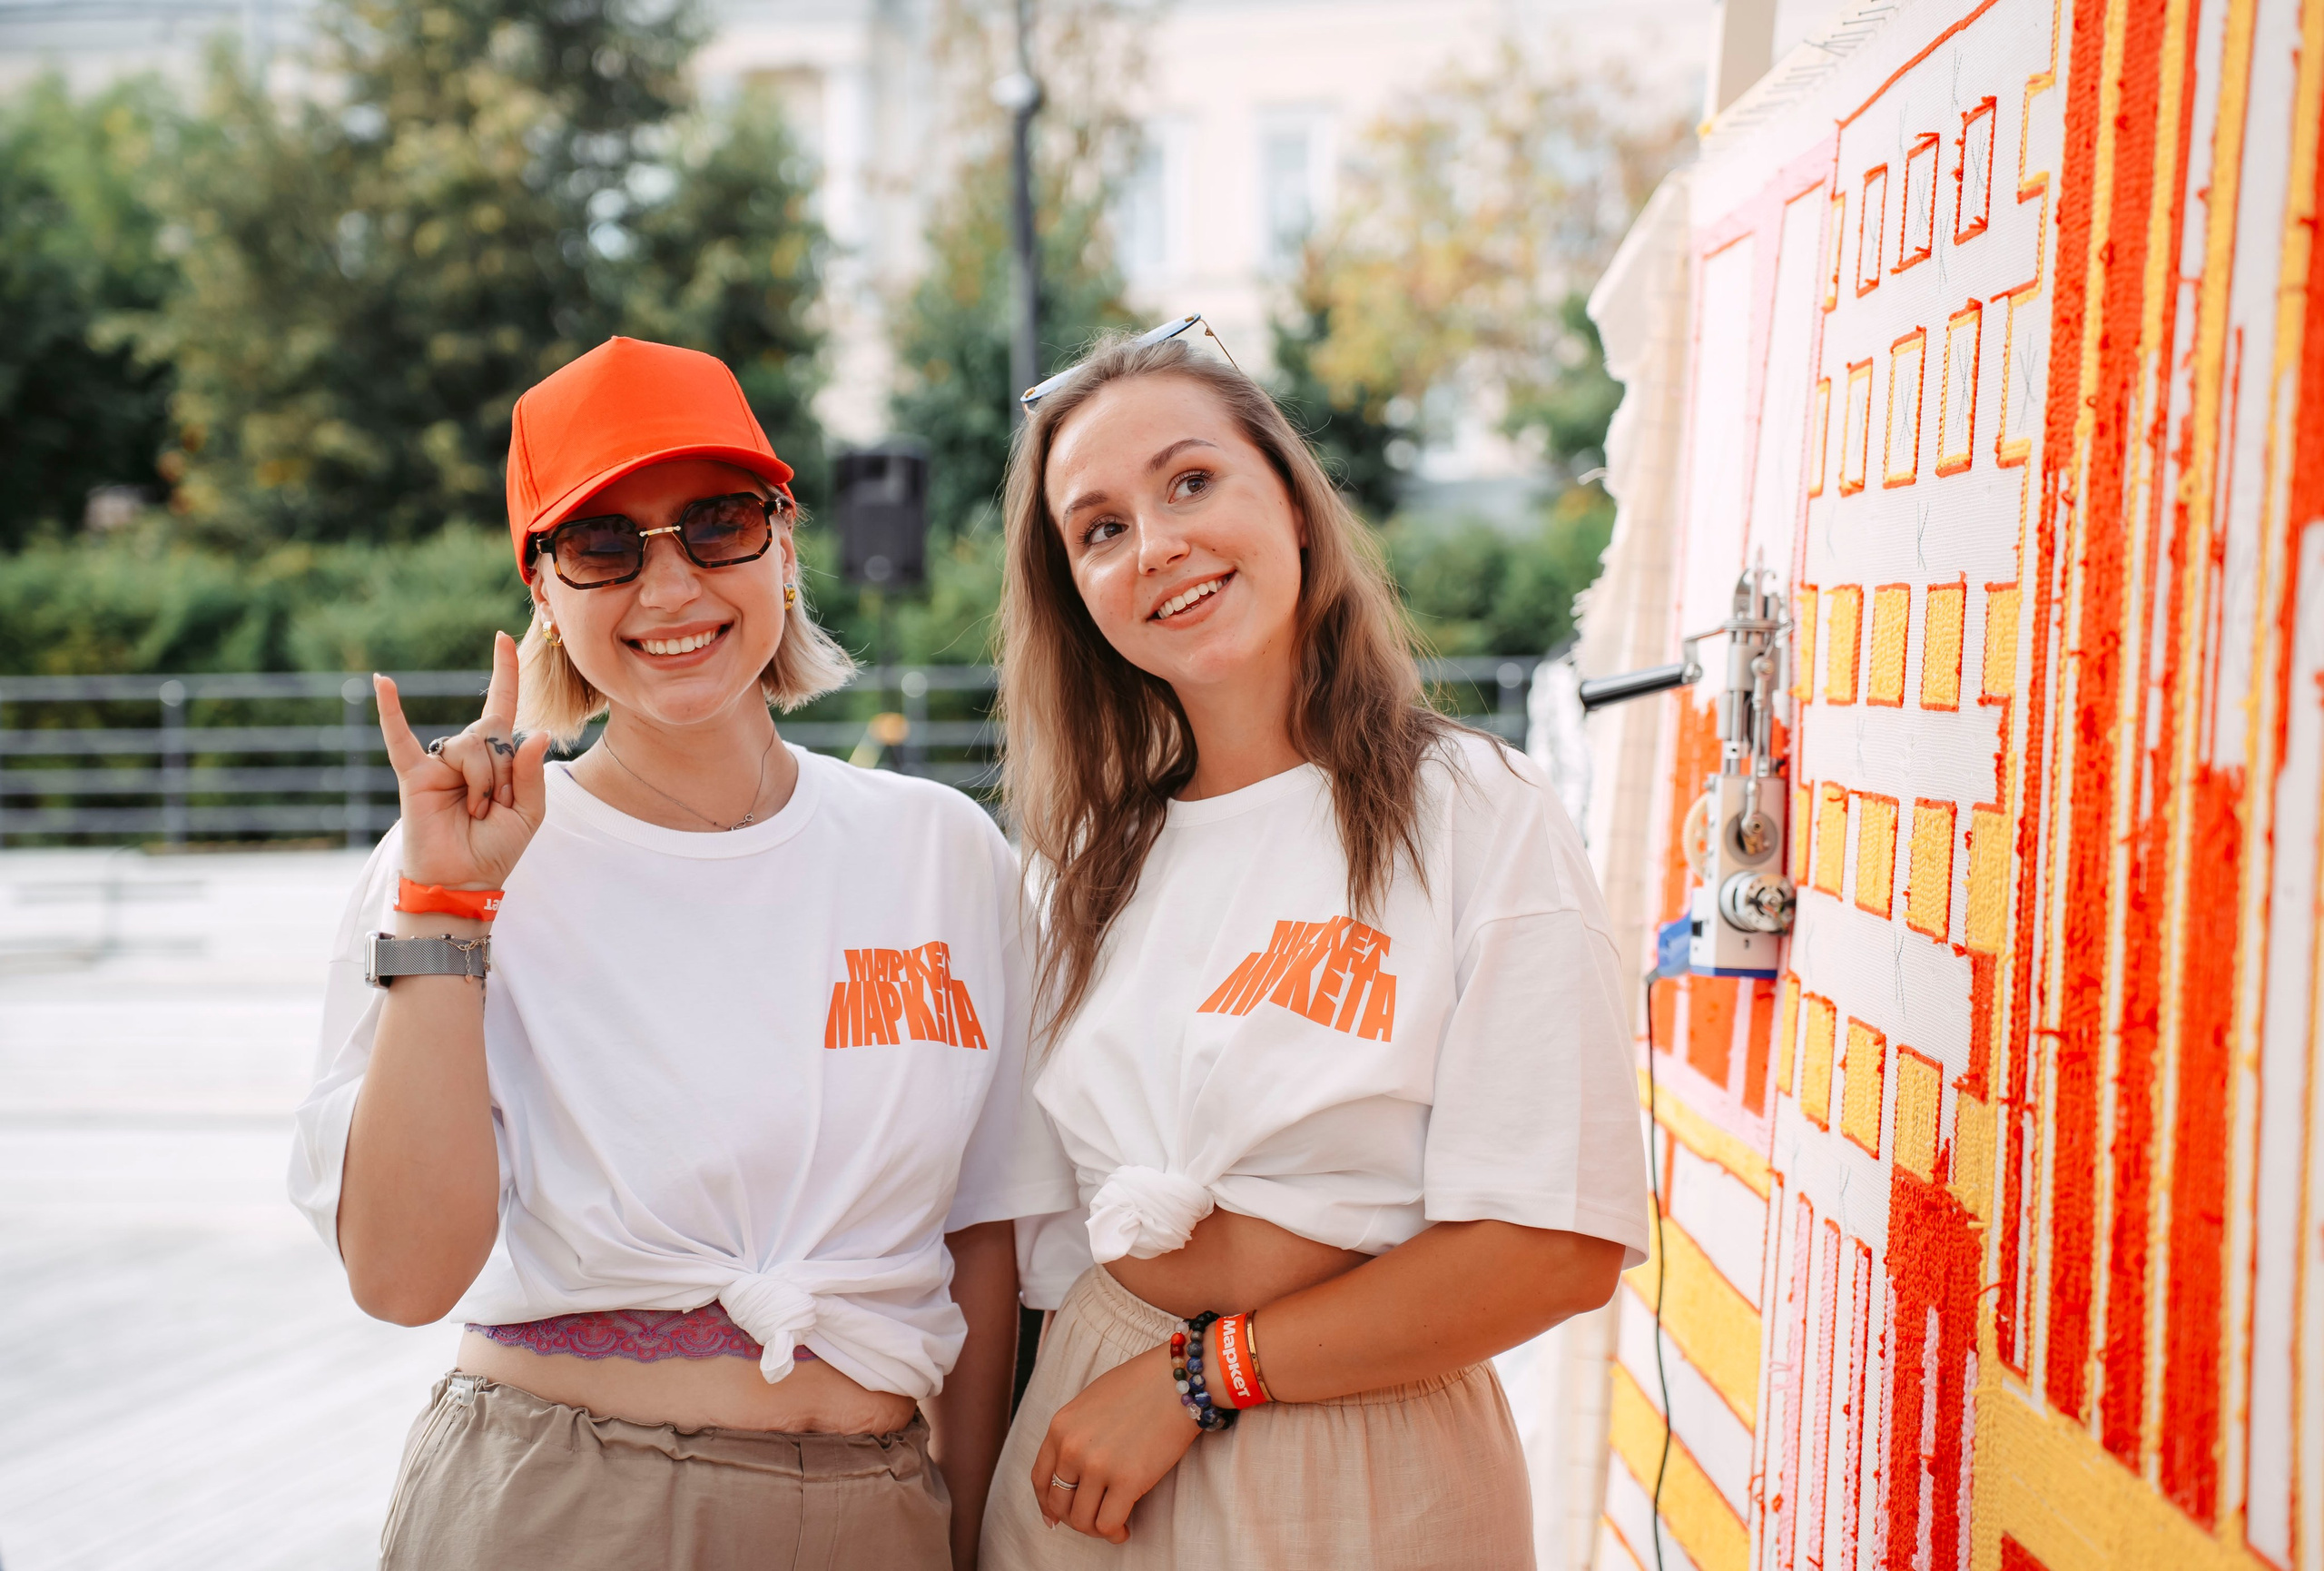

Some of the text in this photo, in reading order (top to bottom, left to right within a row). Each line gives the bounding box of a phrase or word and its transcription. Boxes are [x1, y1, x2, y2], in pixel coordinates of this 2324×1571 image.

[1267, 915, 1392, 968] МАКЕТ
[1196, 943, 1397, 1042] МАКЕТА
[1223, 1319, 1251, 1398] Маркет
